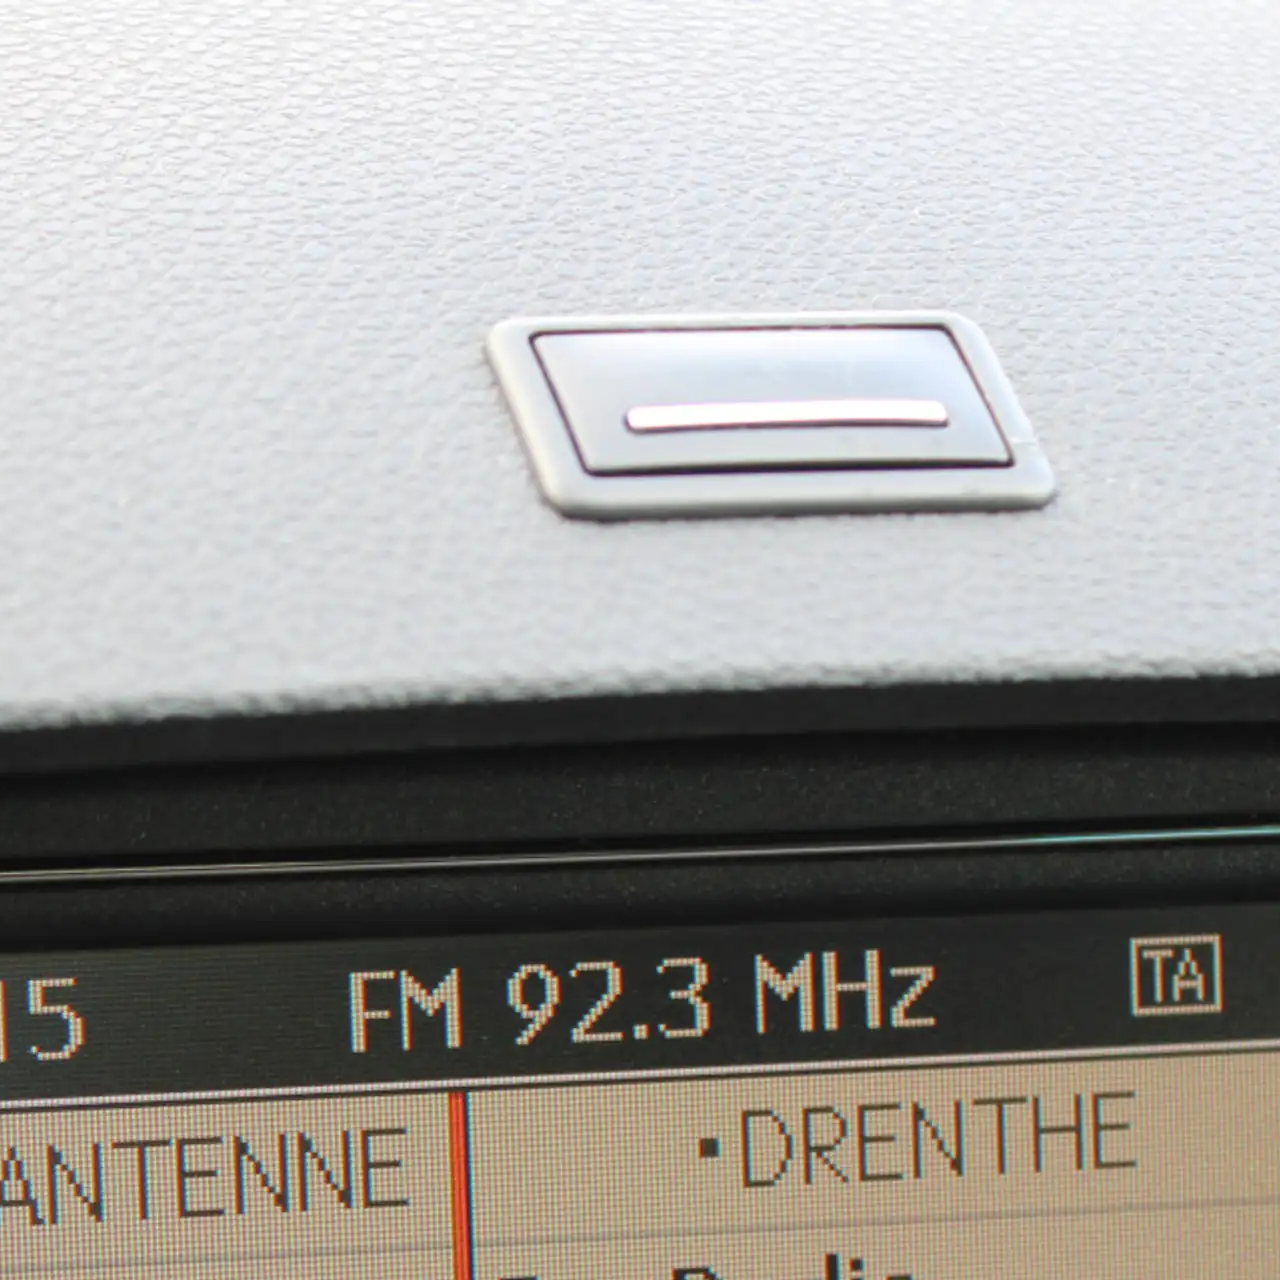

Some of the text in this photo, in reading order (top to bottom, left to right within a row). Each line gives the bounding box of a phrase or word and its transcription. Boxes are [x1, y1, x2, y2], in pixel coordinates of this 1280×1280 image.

[349, 949, 935, 1052] FM 92.3 MHz
[1142, 947, 1206, 1003] TA
[740, 1091, 1137, 1188] DRENTHE
